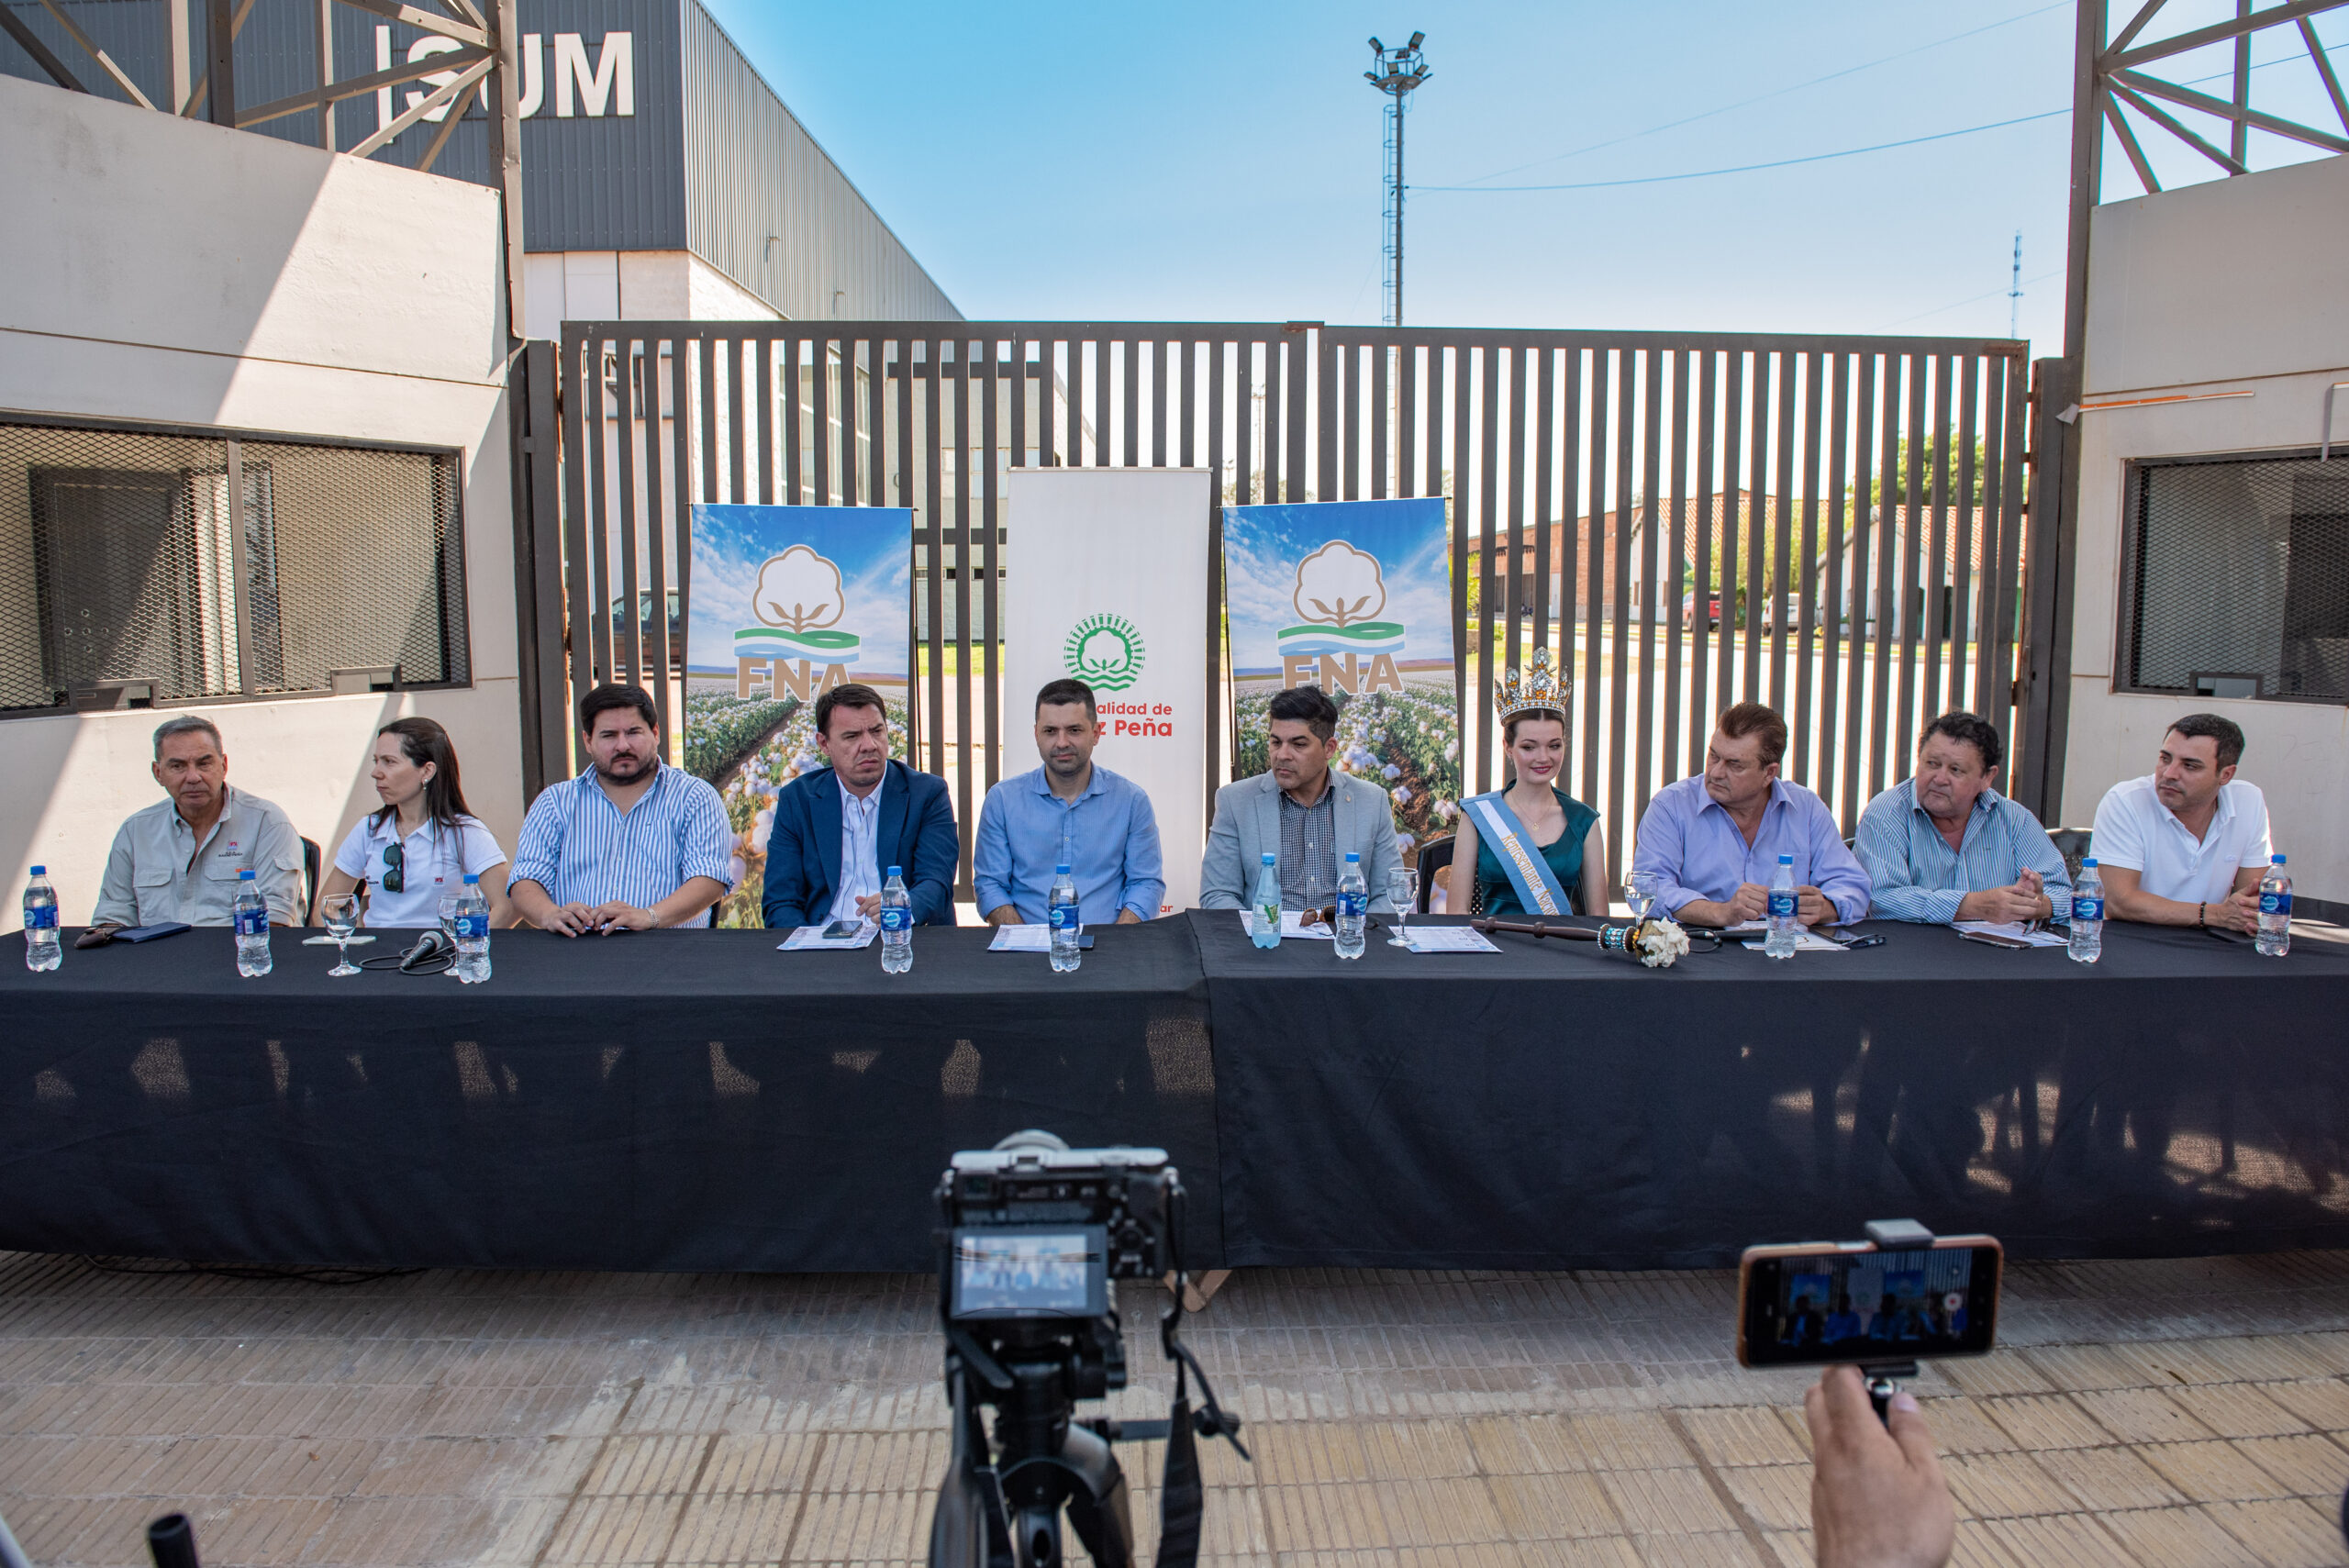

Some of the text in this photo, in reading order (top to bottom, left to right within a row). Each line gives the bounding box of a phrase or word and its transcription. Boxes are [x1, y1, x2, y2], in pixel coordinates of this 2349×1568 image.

[737, 657, 852, 703] FNA
[1283, 652, 1406, 695] FNA
[1097, 702, 1173, 716] alidad de
[1114, 717, 1173, 737] Peña
[1501, 832, 1542, 892] Representante
